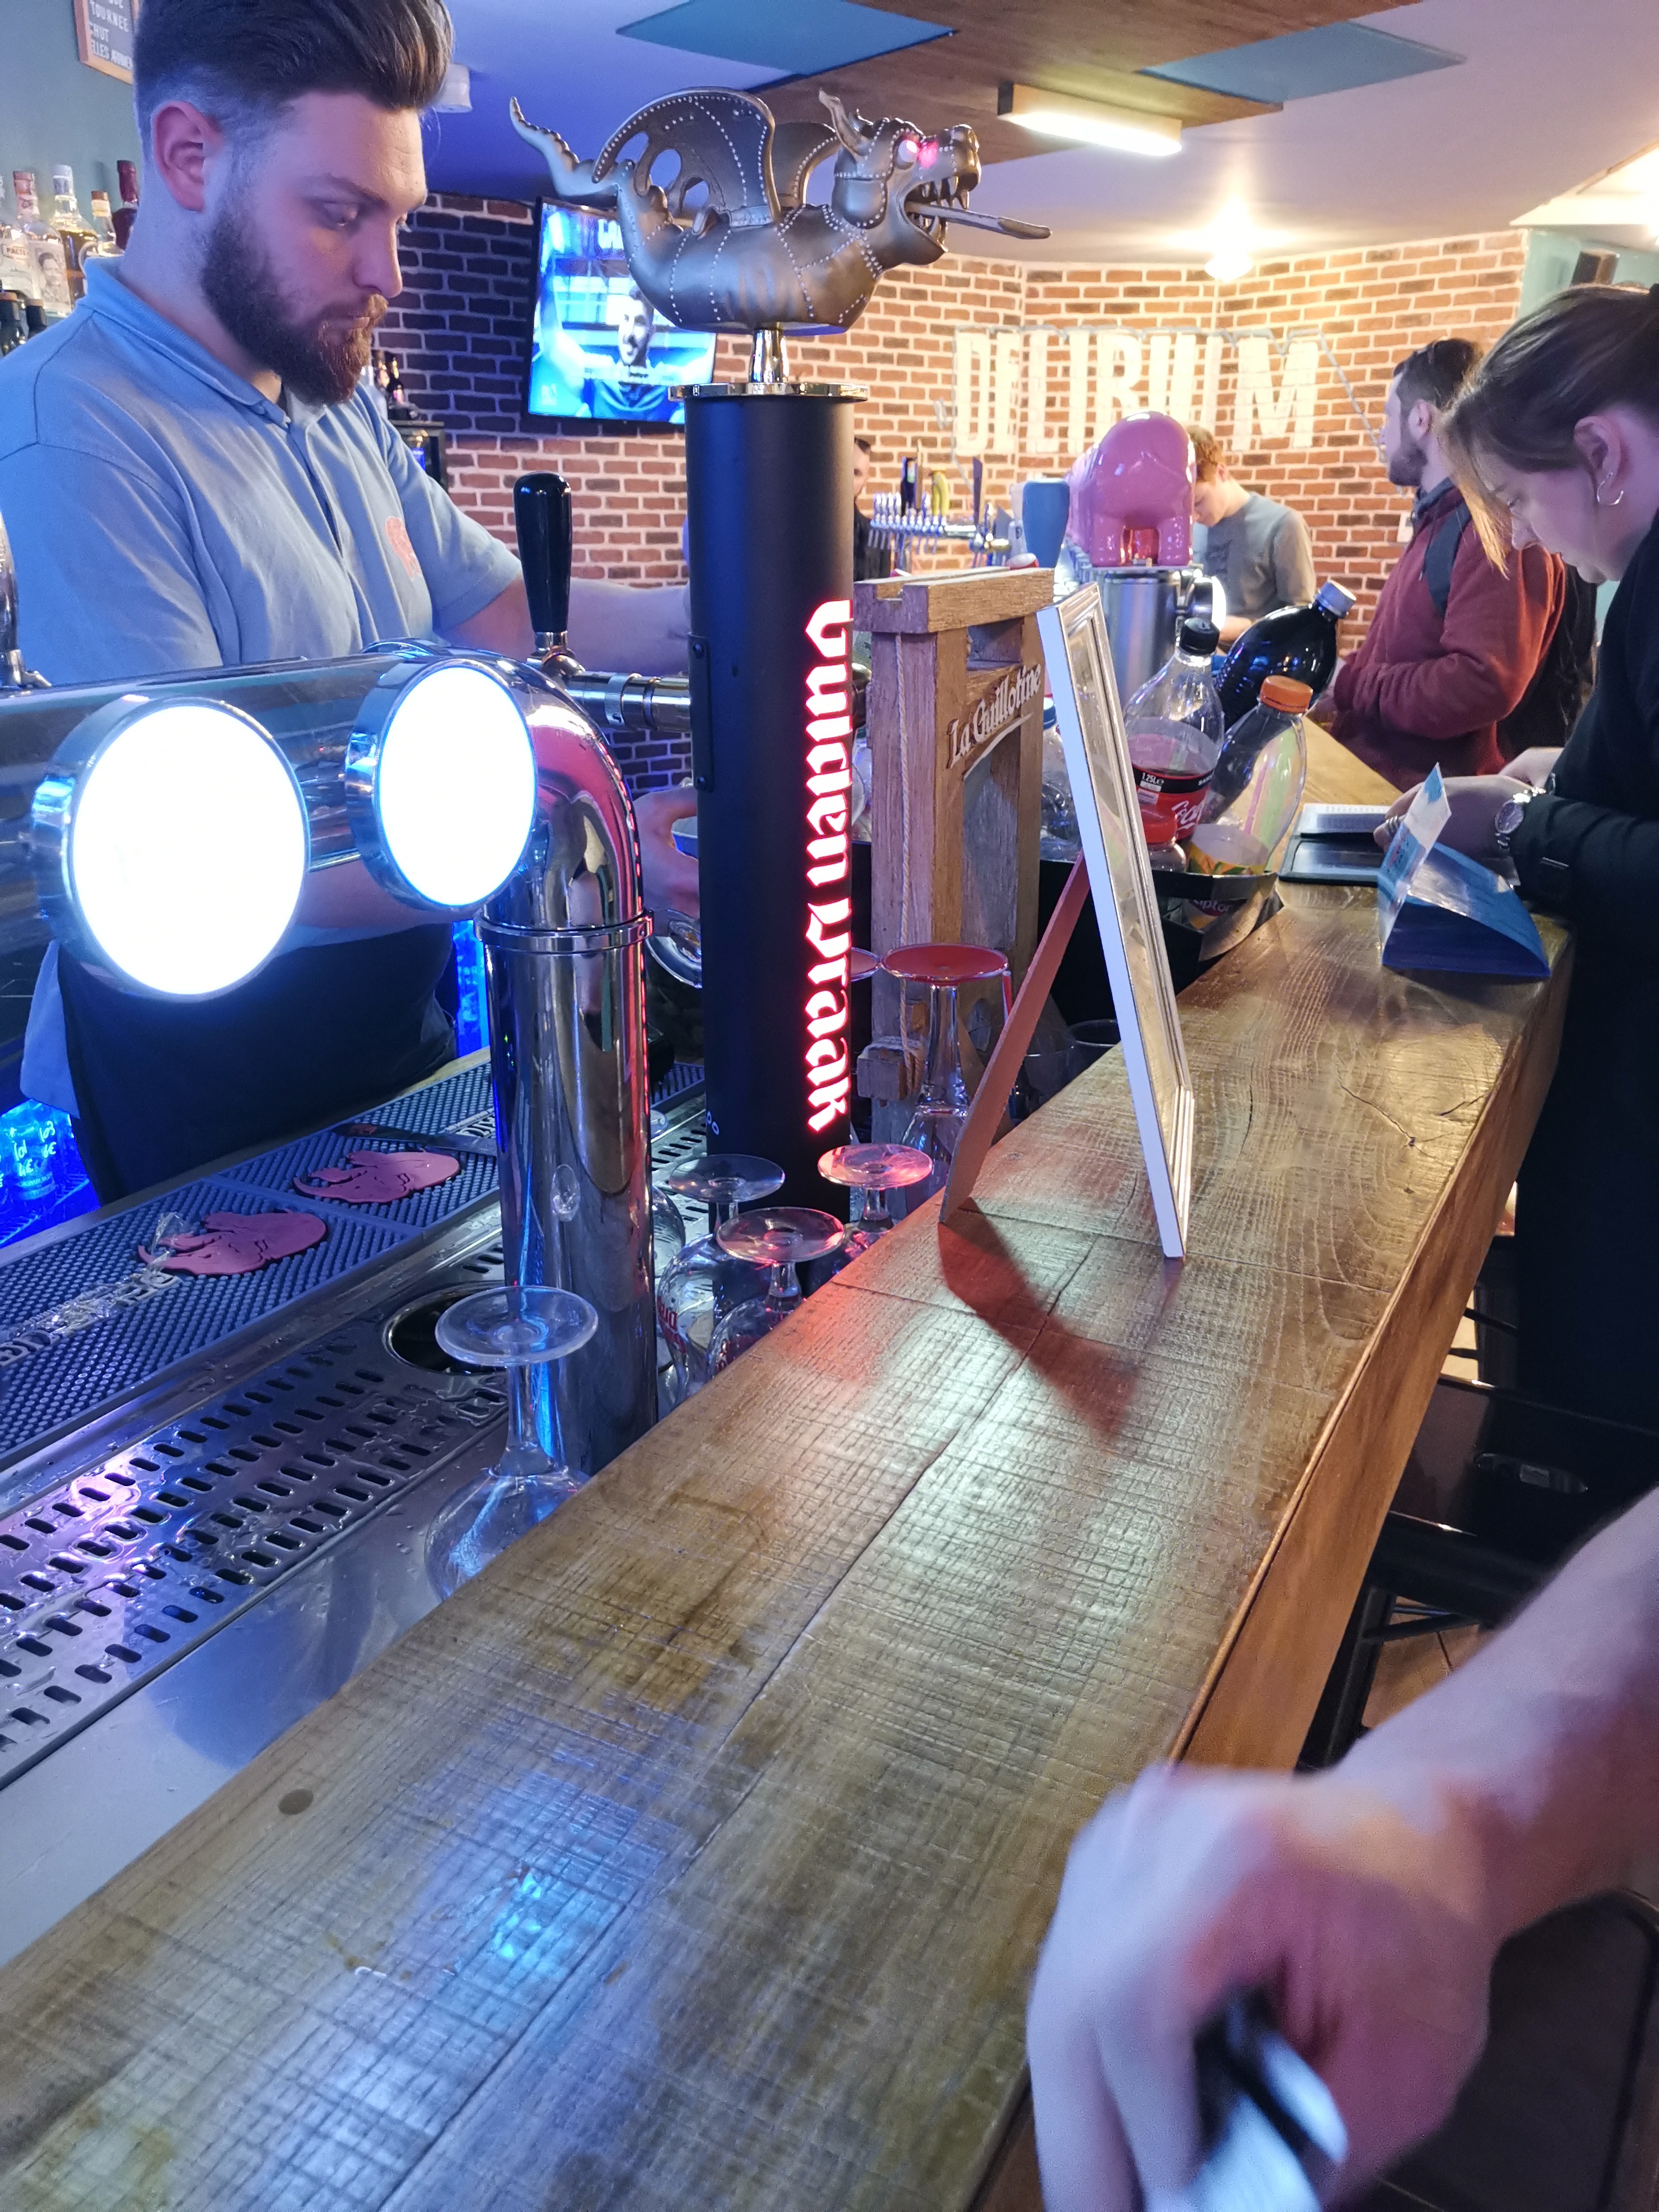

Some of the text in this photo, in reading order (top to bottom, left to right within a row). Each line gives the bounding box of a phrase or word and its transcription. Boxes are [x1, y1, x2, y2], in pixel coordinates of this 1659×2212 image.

[955, 328, 1319, 456] DELIRIUM
[949, 663, 1041, 769] La Guillotine
[804, 598, 854, 1133] Gulden Draak
